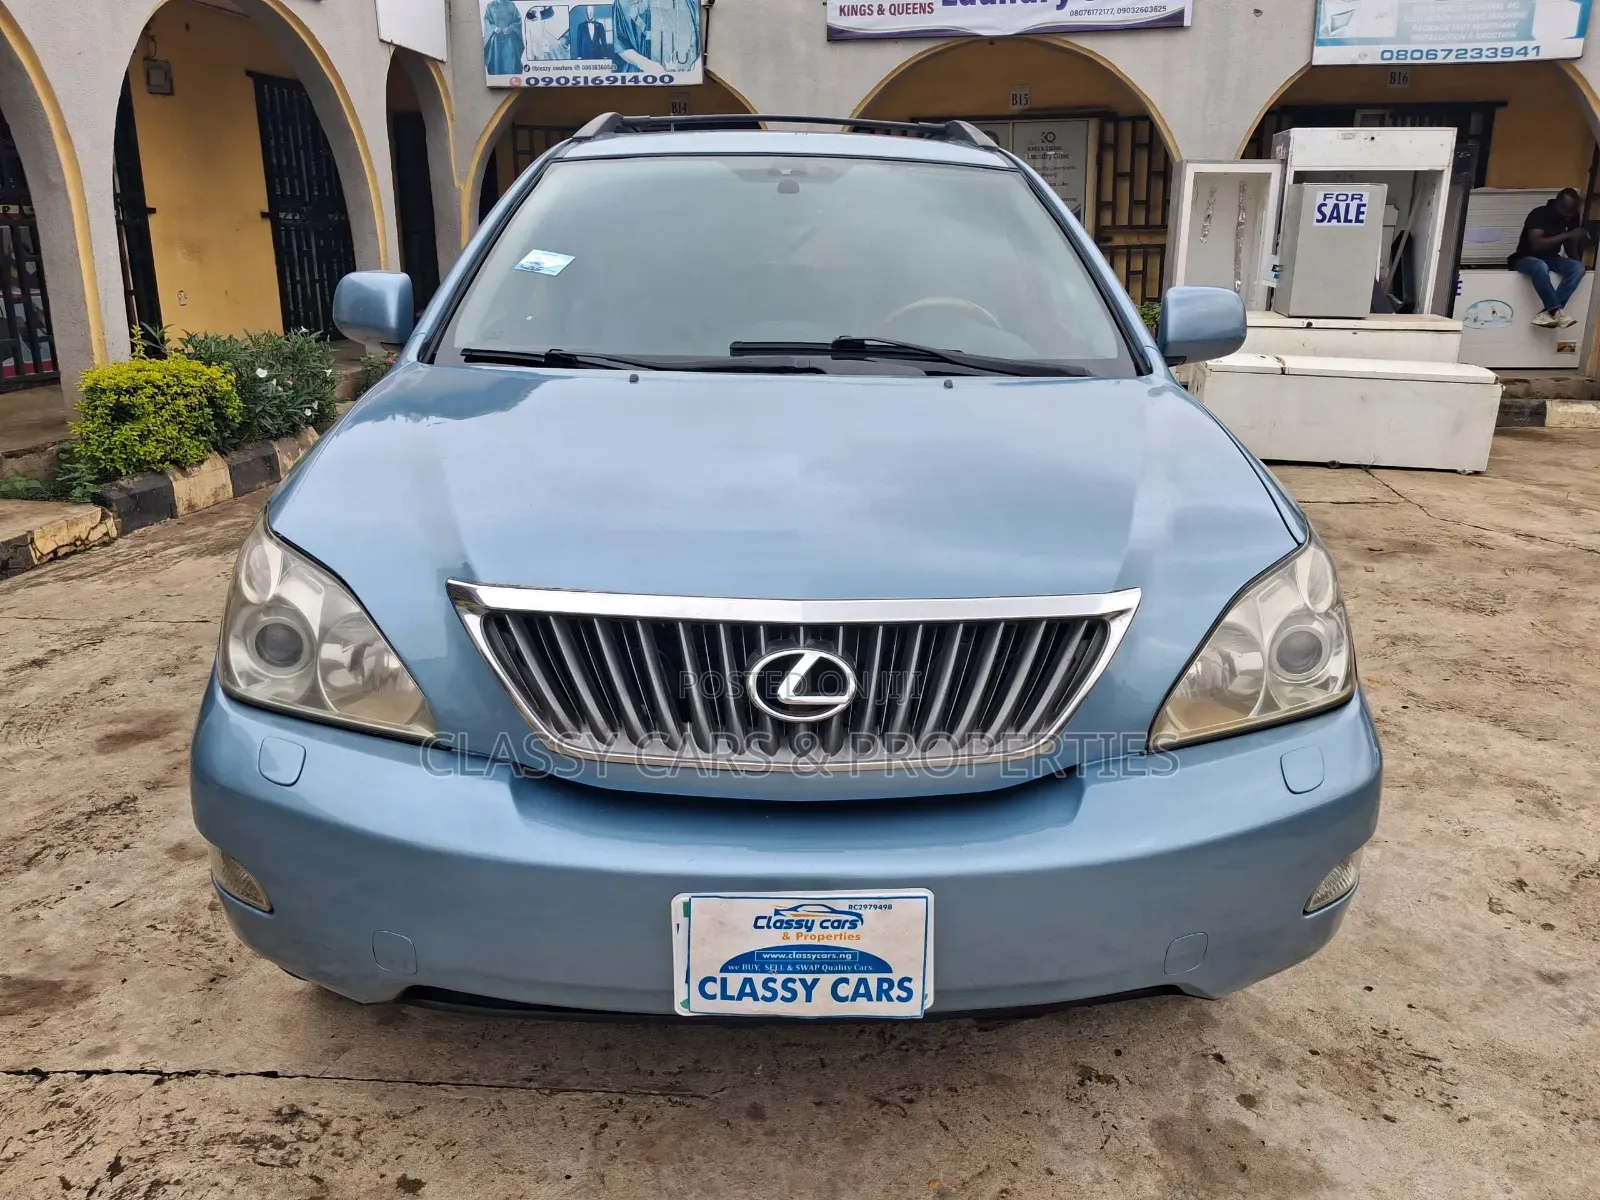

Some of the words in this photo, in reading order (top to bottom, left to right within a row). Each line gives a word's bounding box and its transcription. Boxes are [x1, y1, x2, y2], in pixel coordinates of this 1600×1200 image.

[839, 4, 874, 16] KINGS
[877, 4, 885, 16] &
[889, 2, 935, 16] QUEENS
[1069, 8, 1115, 17] 08076172177,
[1117, 6, 1167, 15] 09032603625
[1380, 45, 1541, 61] 08067233941
[525, 74, 675, 87] 09051691400
[1388, 71, 1409, 86] B16
[1011, 93, 1029, 106] B15
[671, 101, 688, 114] B14
[1322, 192, 1364, 202] FOR
[1315, 202, 1367, 224] SALE
[848, 903, 893, 911] RC2979498
[753, 915, 815, 932] Classy
[820, 918, 860, 930] cars
[782, 932, 791, 940] &
[796, 931, 861, 942] Properties
[762, 951, 852, 960] www.classycars.ng
[822, 964, 853, 973] Quality
[854, 963, 875, 971] Cars.
[698, 975, 821, 1004] CLASSY
[830, 975, 914, 1004] CARS
